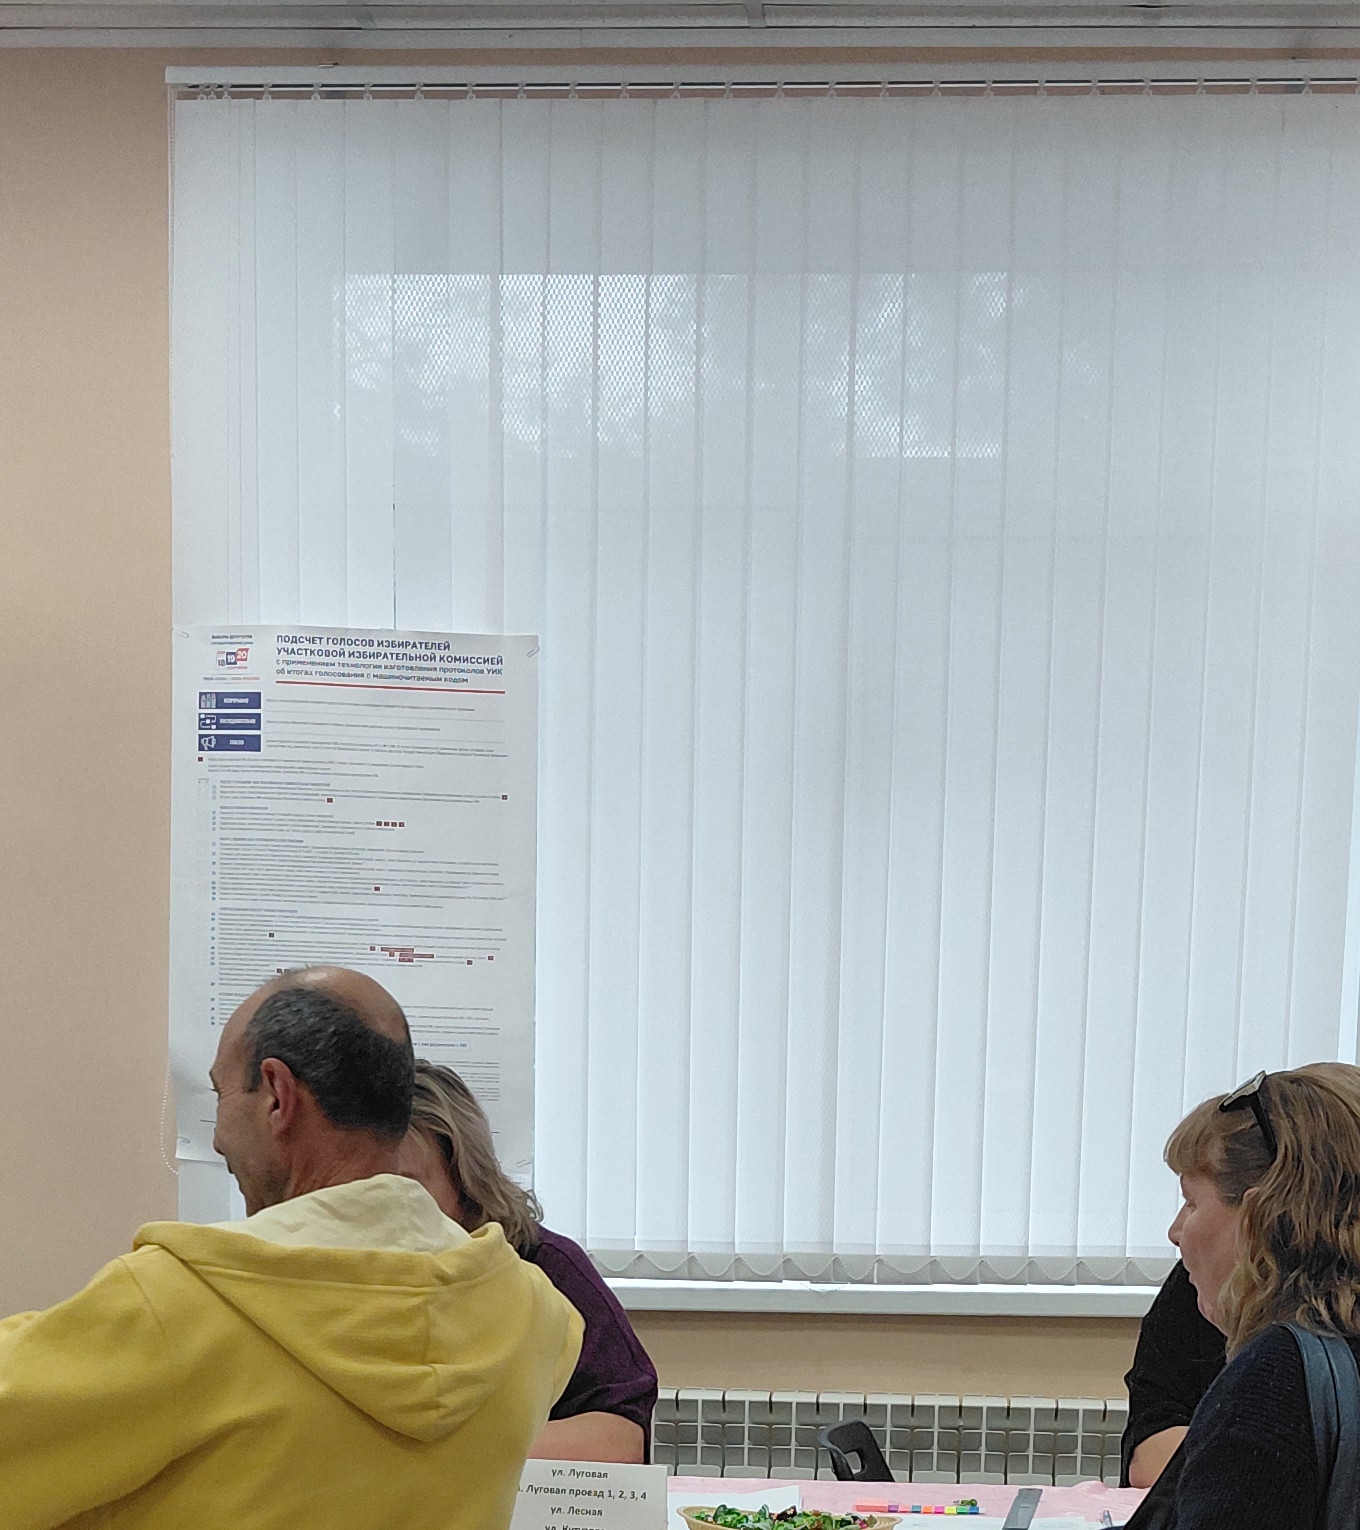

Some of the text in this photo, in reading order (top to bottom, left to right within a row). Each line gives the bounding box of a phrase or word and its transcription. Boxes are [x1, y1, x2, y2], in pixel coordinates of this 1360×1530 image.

[276, 635, 450, 651] ПОДСЧЕТ ГОЛОСОВ ИЗБИРАТЕЛЕЙ
[276, 647, 503, 666] УЧАСТКОВОЙ ИЗБИРАТЕЛЬНОЙ КОМИССИЕЙ
[551, 1468, 608, 1479] ул. Луговая
[641, 1491, 647, 1500] 4
[551, 1506, 602, 1516] ул. Лесная
